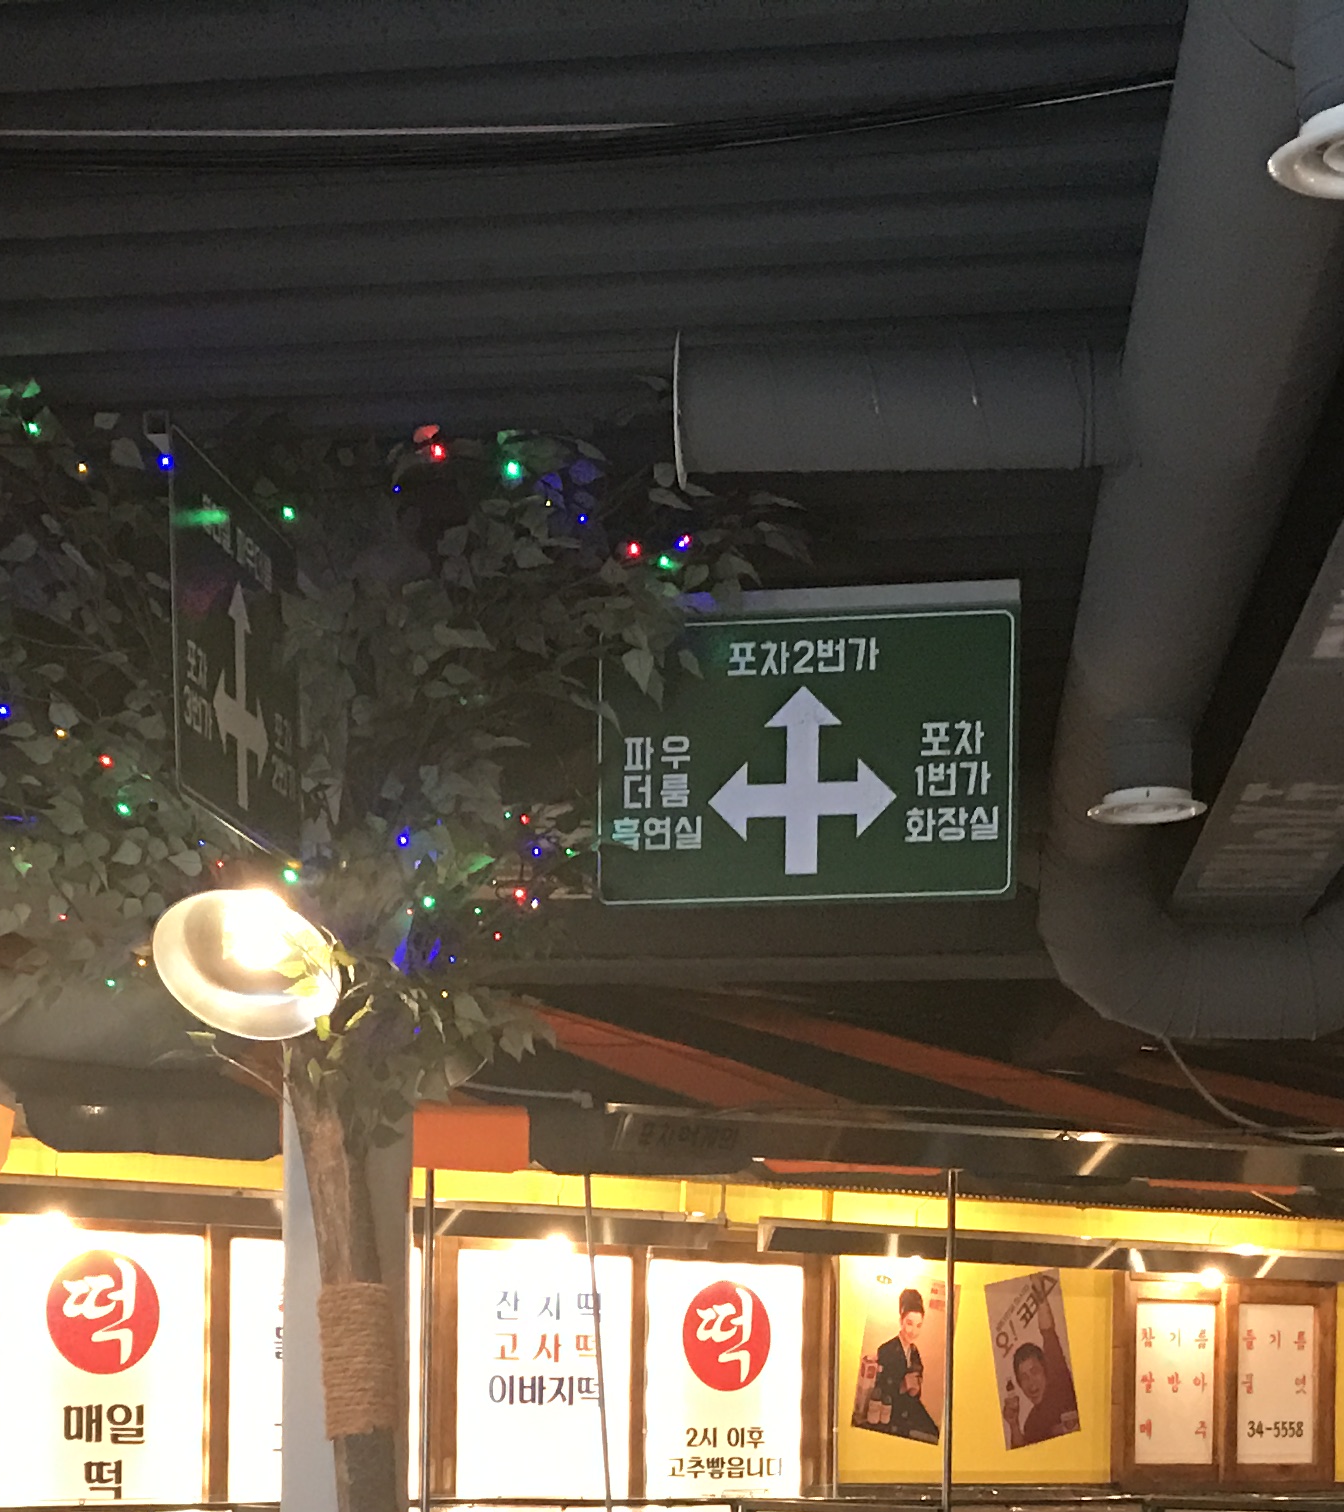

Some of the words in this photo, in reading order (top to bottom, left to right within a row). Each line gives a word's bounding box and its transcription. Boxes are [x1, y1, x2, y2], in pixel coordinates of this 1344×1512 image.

[727, 636, 880, 677] 포차2번가
[920, 719, 986, 757] 포차
[914, 760, 992, 798] 1번가
[904, 805, 999, 843] 화장실
[61, 1257, 138, 1366] 떡
[695, 1287, 754, 1384] 떡
[63, 1403, 146, 1445] 매일
[685, 1426, 718, 1448] 2시
[726, 1426, 766, 1449] 이후
[1246, 1420, 1304, 1439] 34-5558
[83, 1459, 123, 1500] 떡
